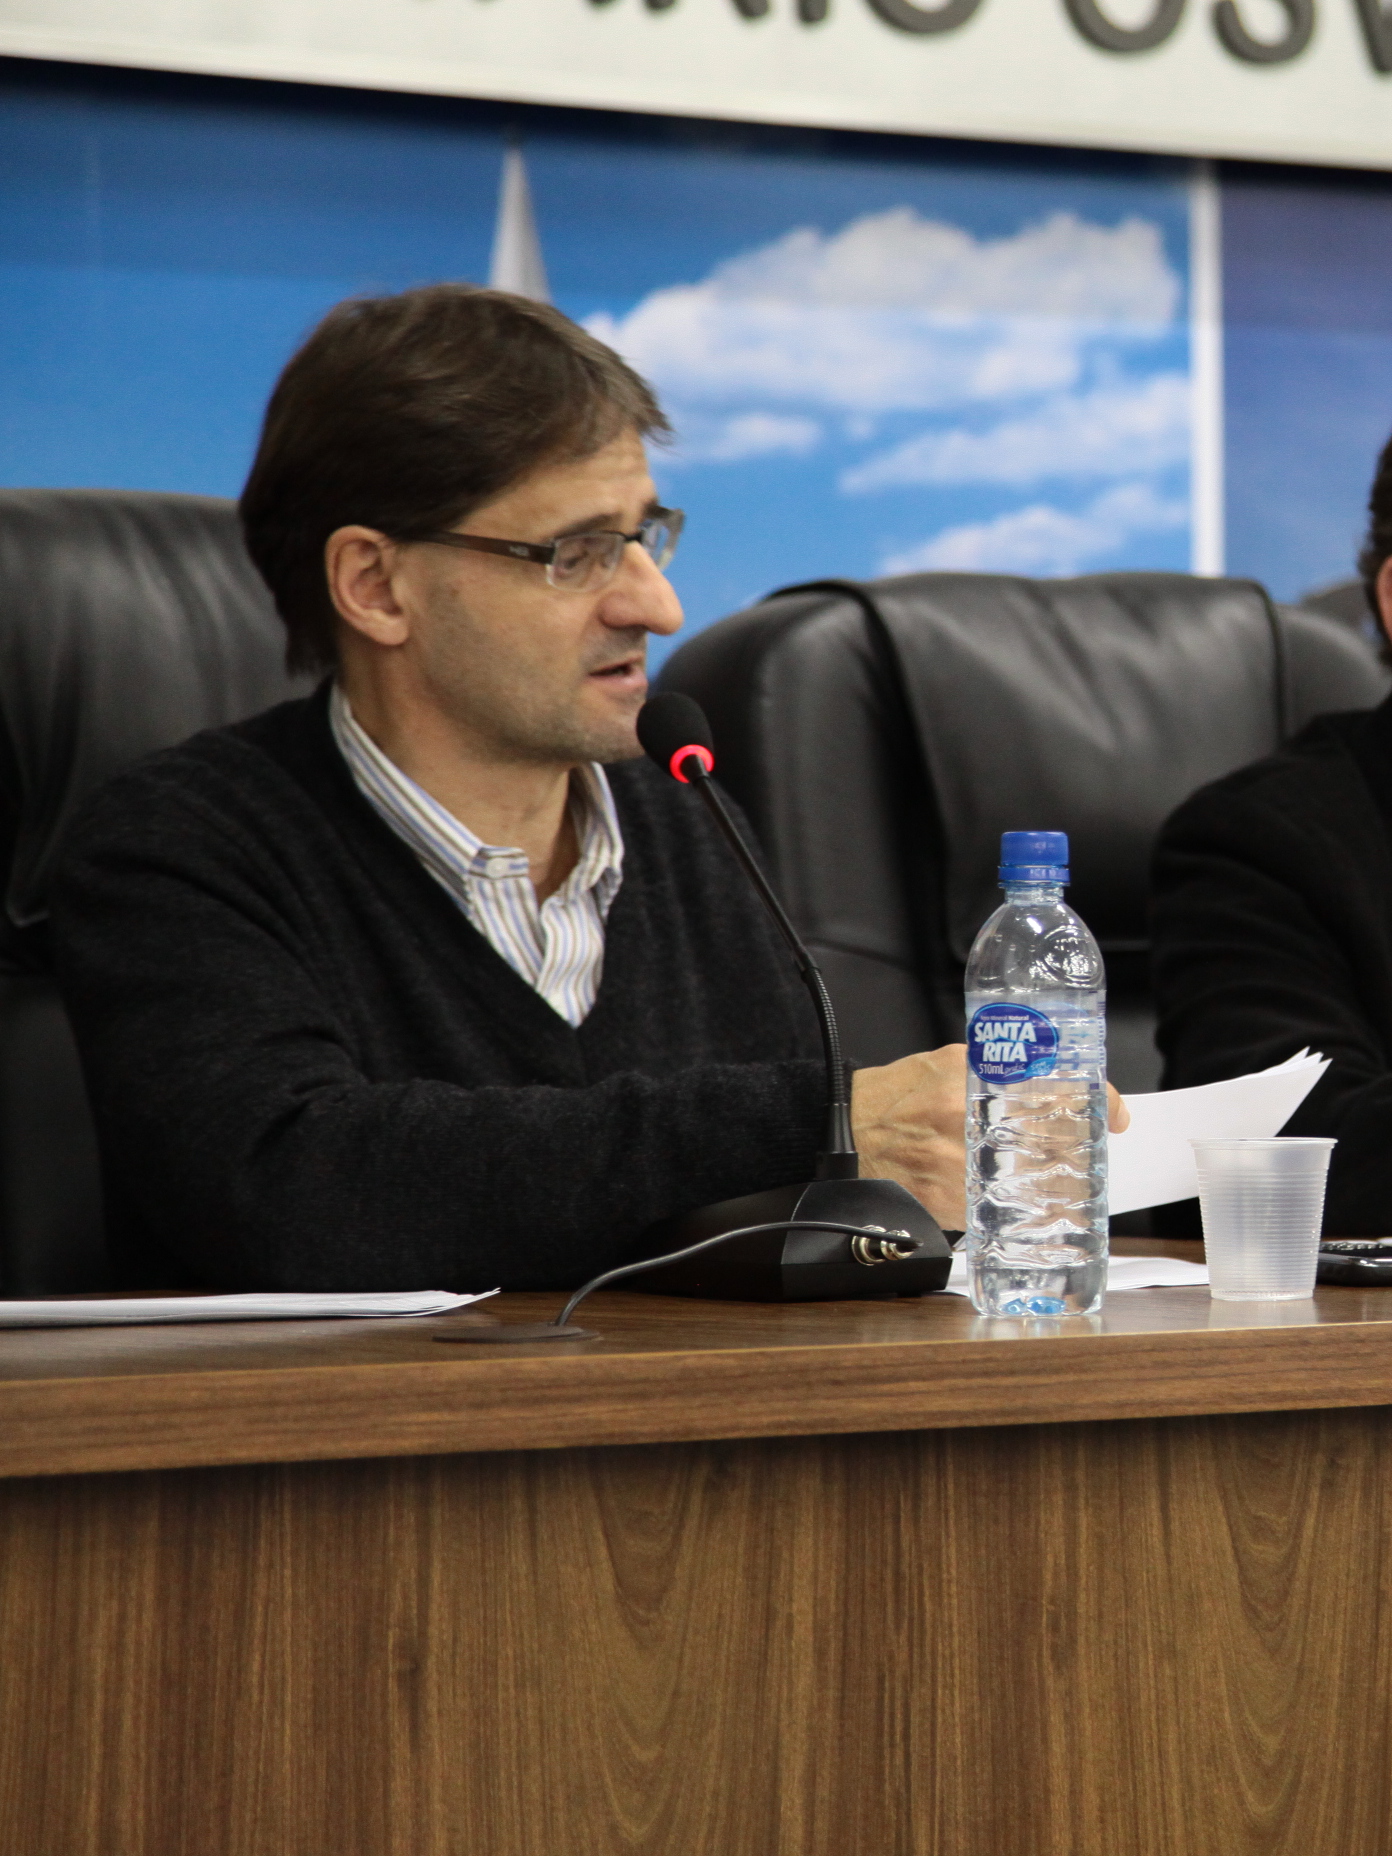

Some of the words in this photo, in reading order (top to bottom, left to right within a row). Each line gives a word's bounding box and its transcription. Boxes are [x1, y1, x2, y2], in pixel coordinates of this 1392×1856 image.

[974, 1021, 1037, 1042] SANTA
[982, 1041, 1028, 1062] RITA
[979, 1063, 1005, 1075] 510mL
